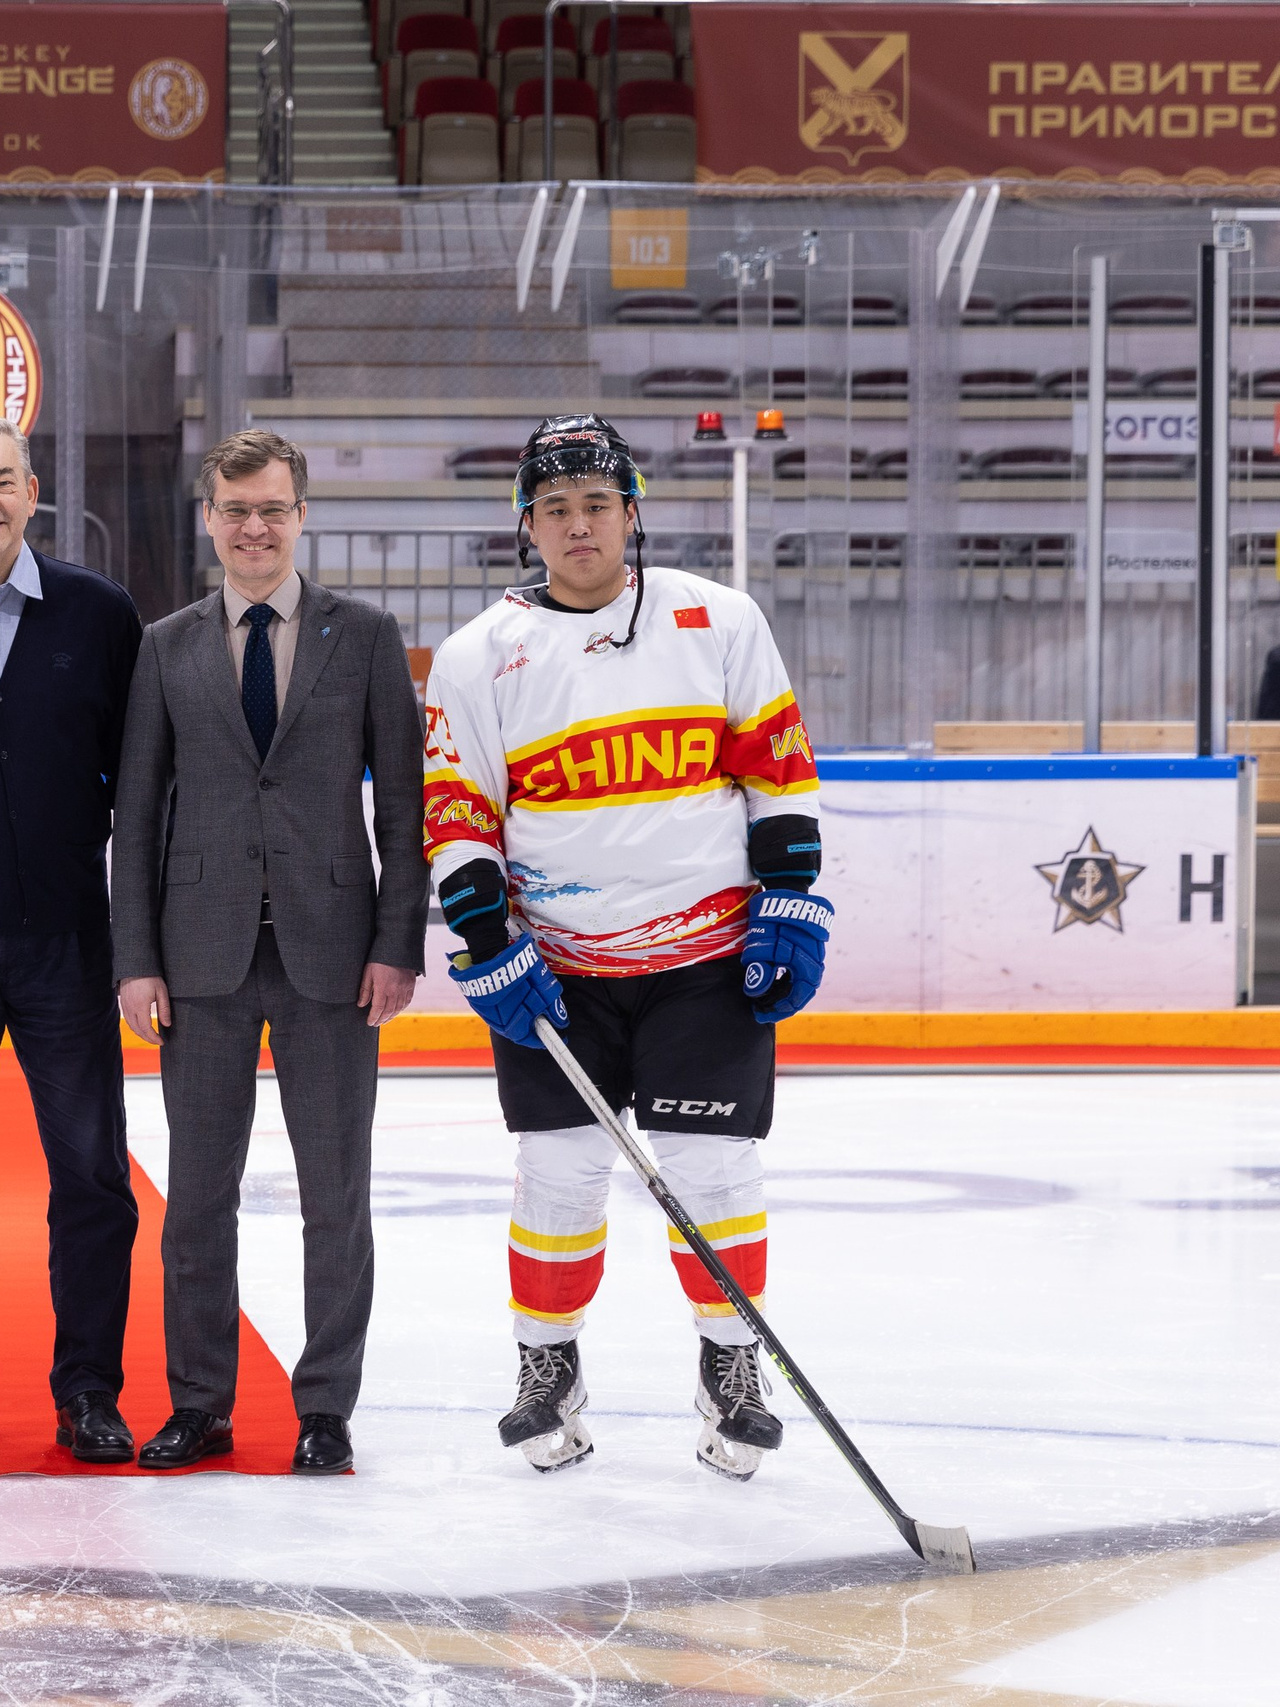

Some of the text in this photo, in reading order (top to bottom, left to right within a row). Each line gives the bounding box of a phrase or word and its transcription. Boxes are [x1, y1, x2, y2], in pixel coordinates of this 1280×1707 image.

[988, 105, 1278, 138] ПРИМОРС
[628, 235, 671, 265] 103
[1105, 414, 1198, 441] огаз
[522, 728, 716, 797] CHINA
[457, 943, 539, 998] WARRIOR
[651, 1097, 738, 1118] CCM
